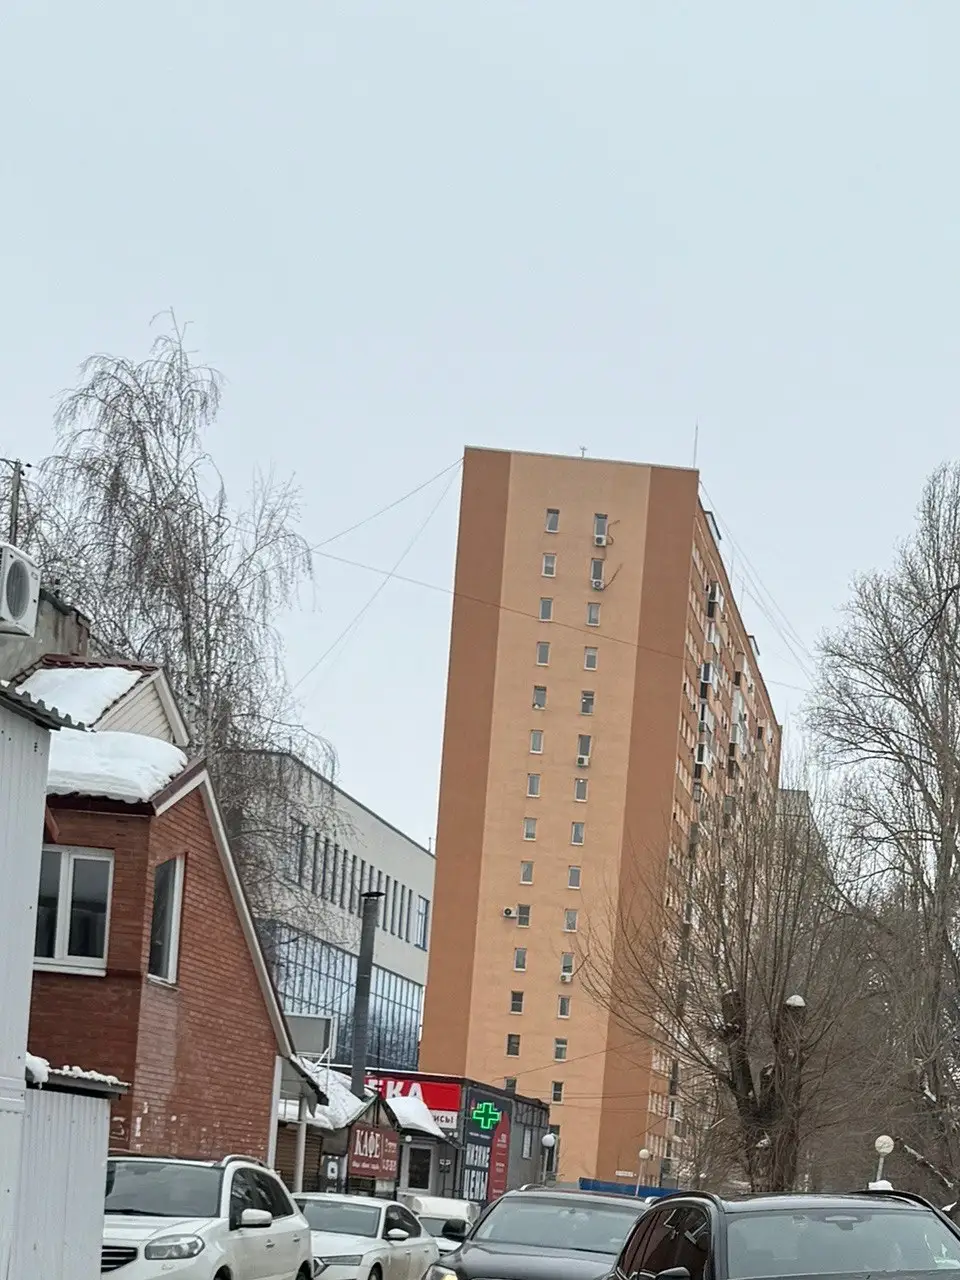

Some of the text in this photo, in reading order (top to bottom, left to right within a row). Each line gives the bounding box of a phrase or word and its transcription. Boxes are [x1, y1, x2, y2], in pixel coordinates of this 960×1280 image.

[367, 1078, 424, 1101] ЕКА
[354, 1129, 381, 1158] КАФЕ
[463, 1169, 489, 1200] ЦЕНЫ
